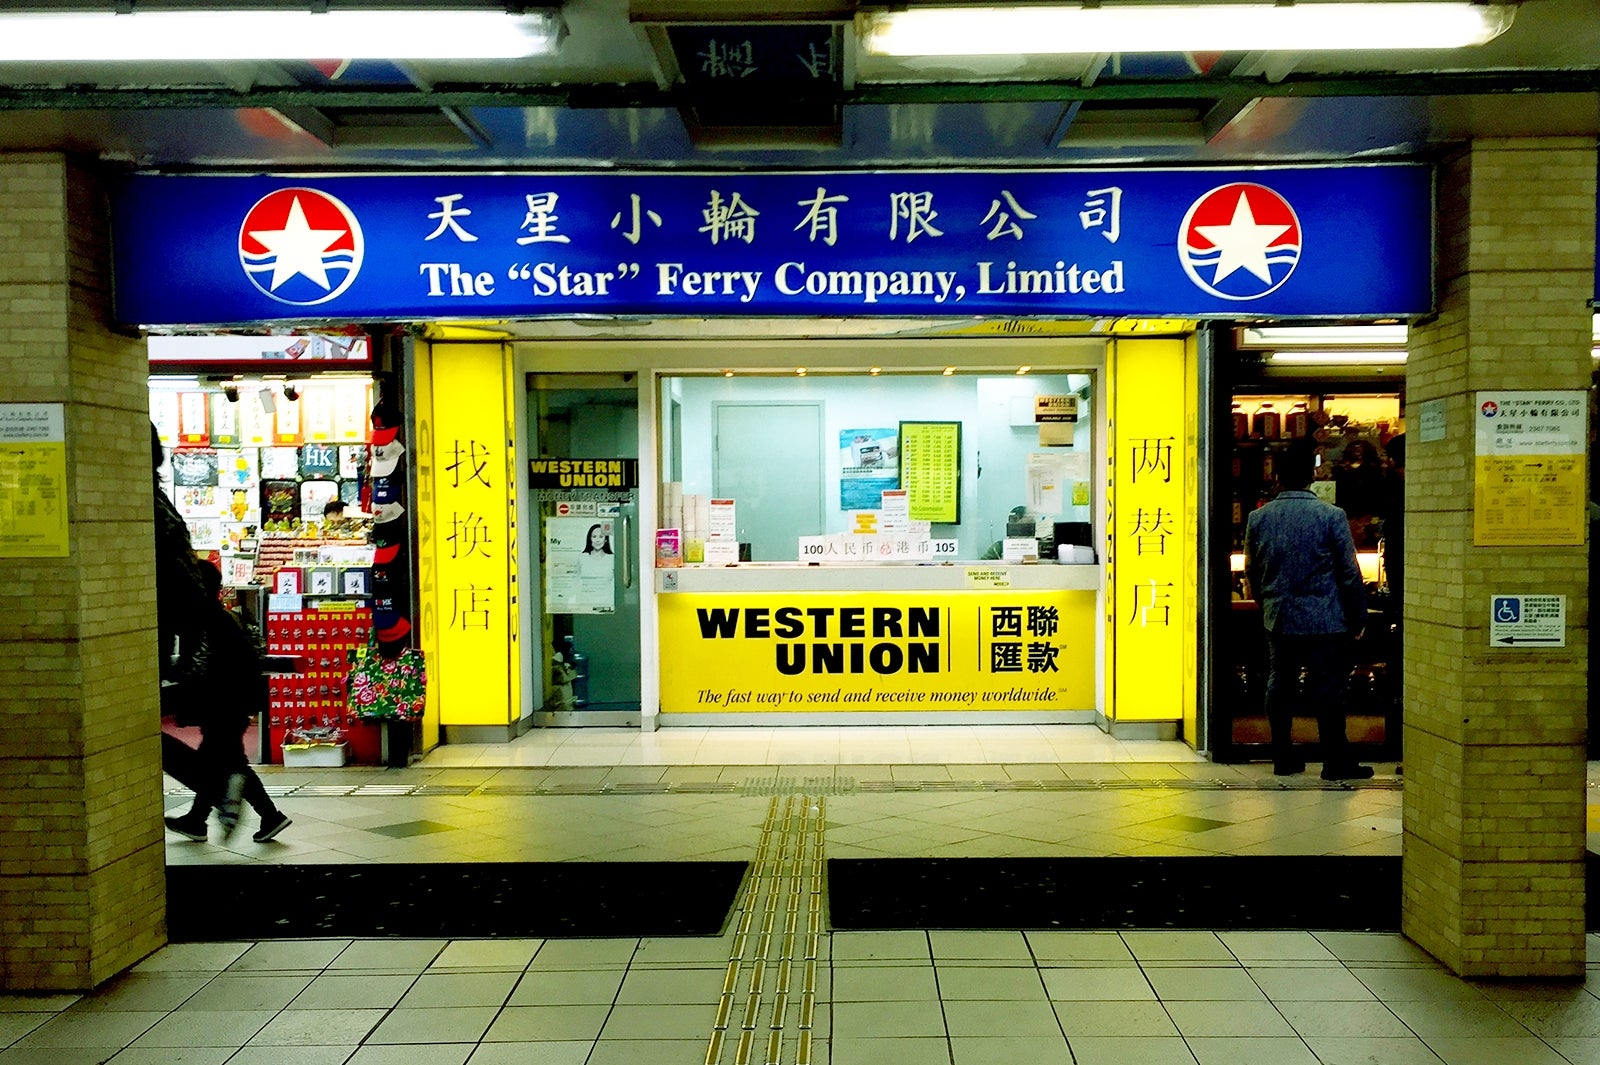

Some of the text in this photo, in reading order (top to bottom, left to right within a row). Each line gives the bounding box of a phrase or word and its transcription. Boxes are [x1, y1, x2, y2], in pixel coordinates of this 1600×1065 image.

[425, 187, 1122, 245] 天星小輪有限公司
[420, 264, 494, 296] The
[656, 264, 762, 302] Ferry
[775, 263, 965, 302] Company,
[977, 261, 1125, 295] Limited
[305, 449, 332, 466] HK
[531, 461, 621, 473] WESTERN
[560, 474, 621, 487] UNION
[445, 440, 492, 630] 找换店
[1129, 436, 1174, 627] 两替店
[804, 545, 823, 554] 100
[935, 543, 955, 552] 105
[697, 607, 939, 638] WESTERN
[991, 606, 1059, 637] 西聯
[776, 643, 939, 675] UNION
[991, 642, 1059, 673] 匯款
[697, 689, 722, 704] The
[722, 689, 752, 707] fast
[756, 692, 786, 707] way
[789, 691, 803, 703] to
[807, 689, 840, 704] send
[843, 689, 871, 704] and
[875, 689, 926, 704] receive
[930, 692, 978, 708] money
[982, 688, 1058, 702] worldwide.
